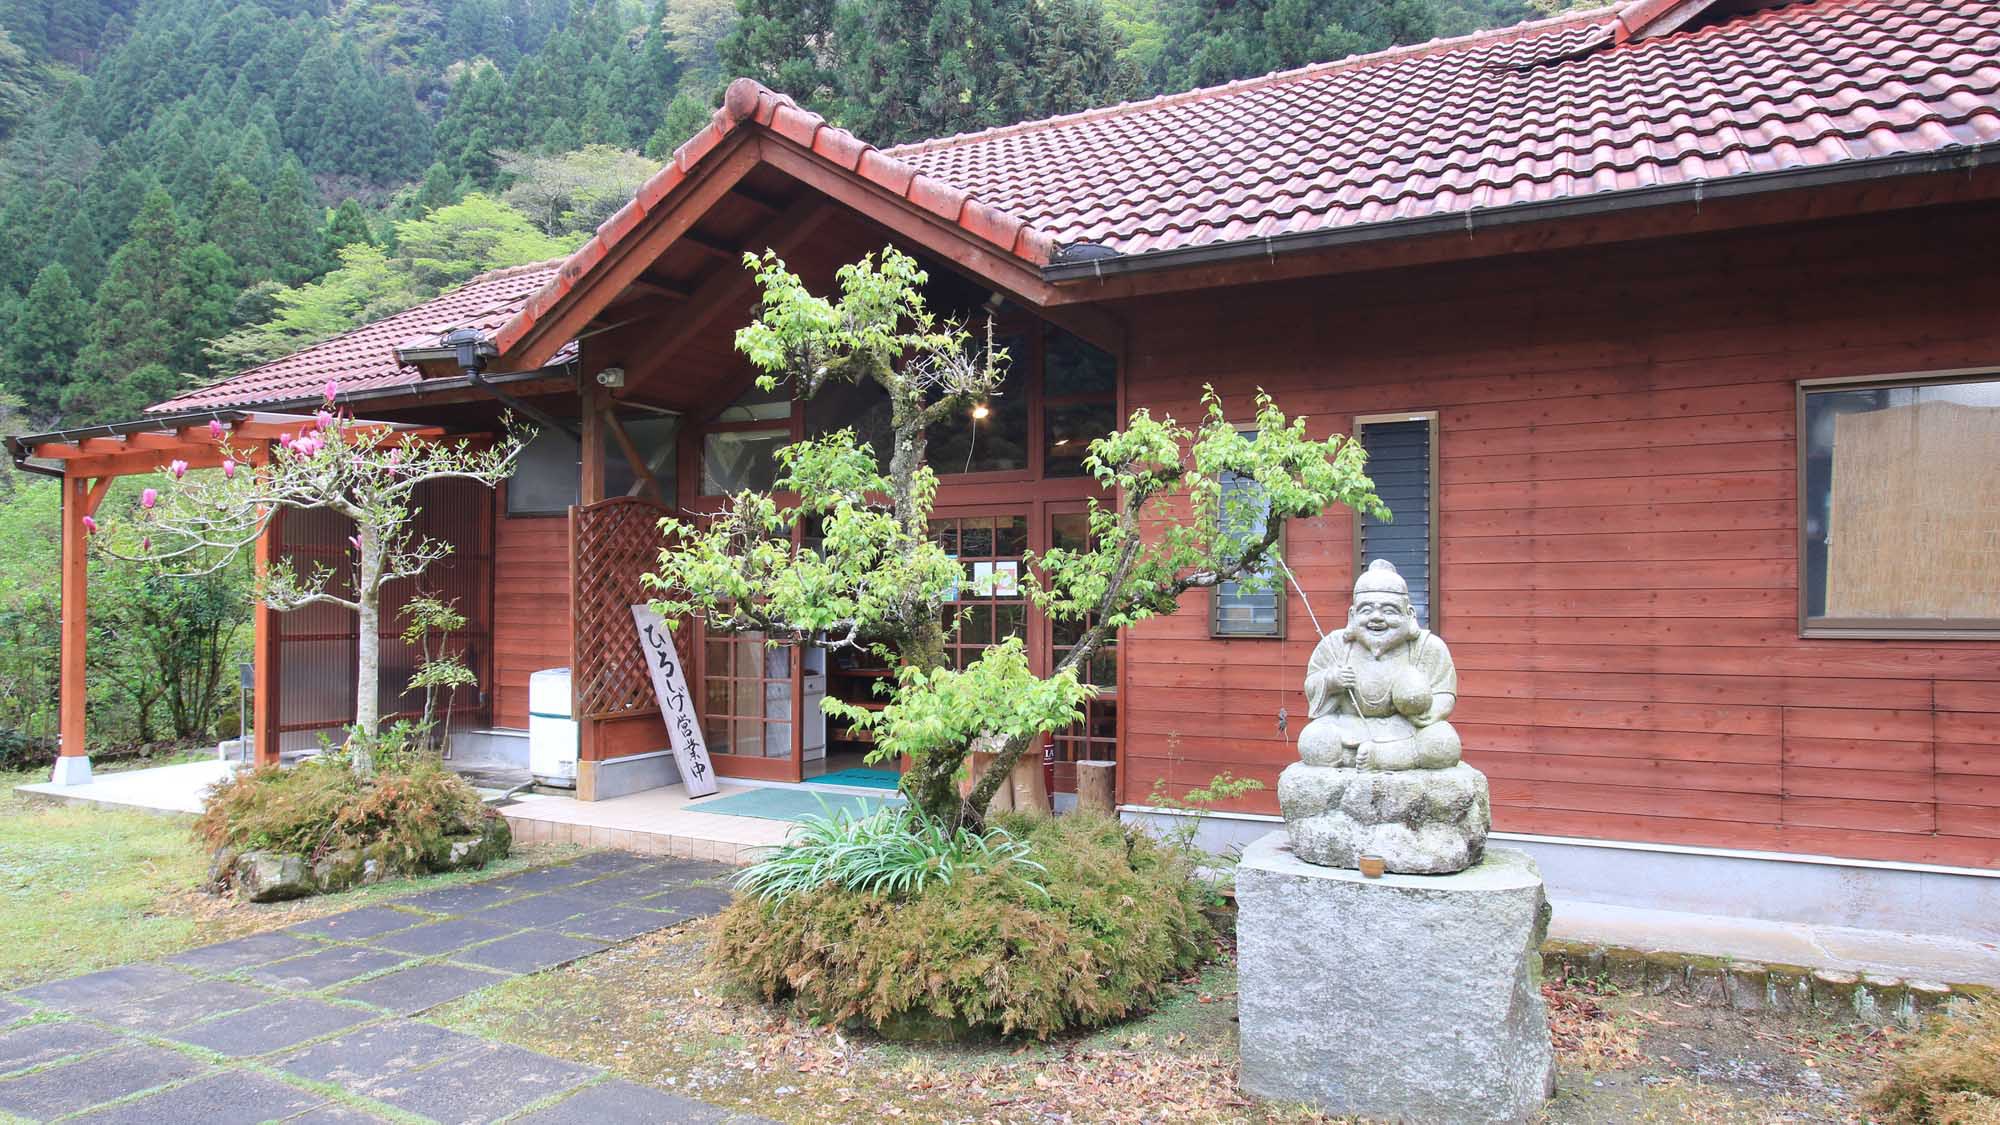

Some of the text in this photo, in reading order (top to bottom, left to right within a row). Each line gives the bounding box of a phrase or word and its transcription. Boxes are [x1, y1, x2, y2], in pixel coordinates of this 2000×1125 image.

[643, 623, 706, 783] ひろしげ営業中
